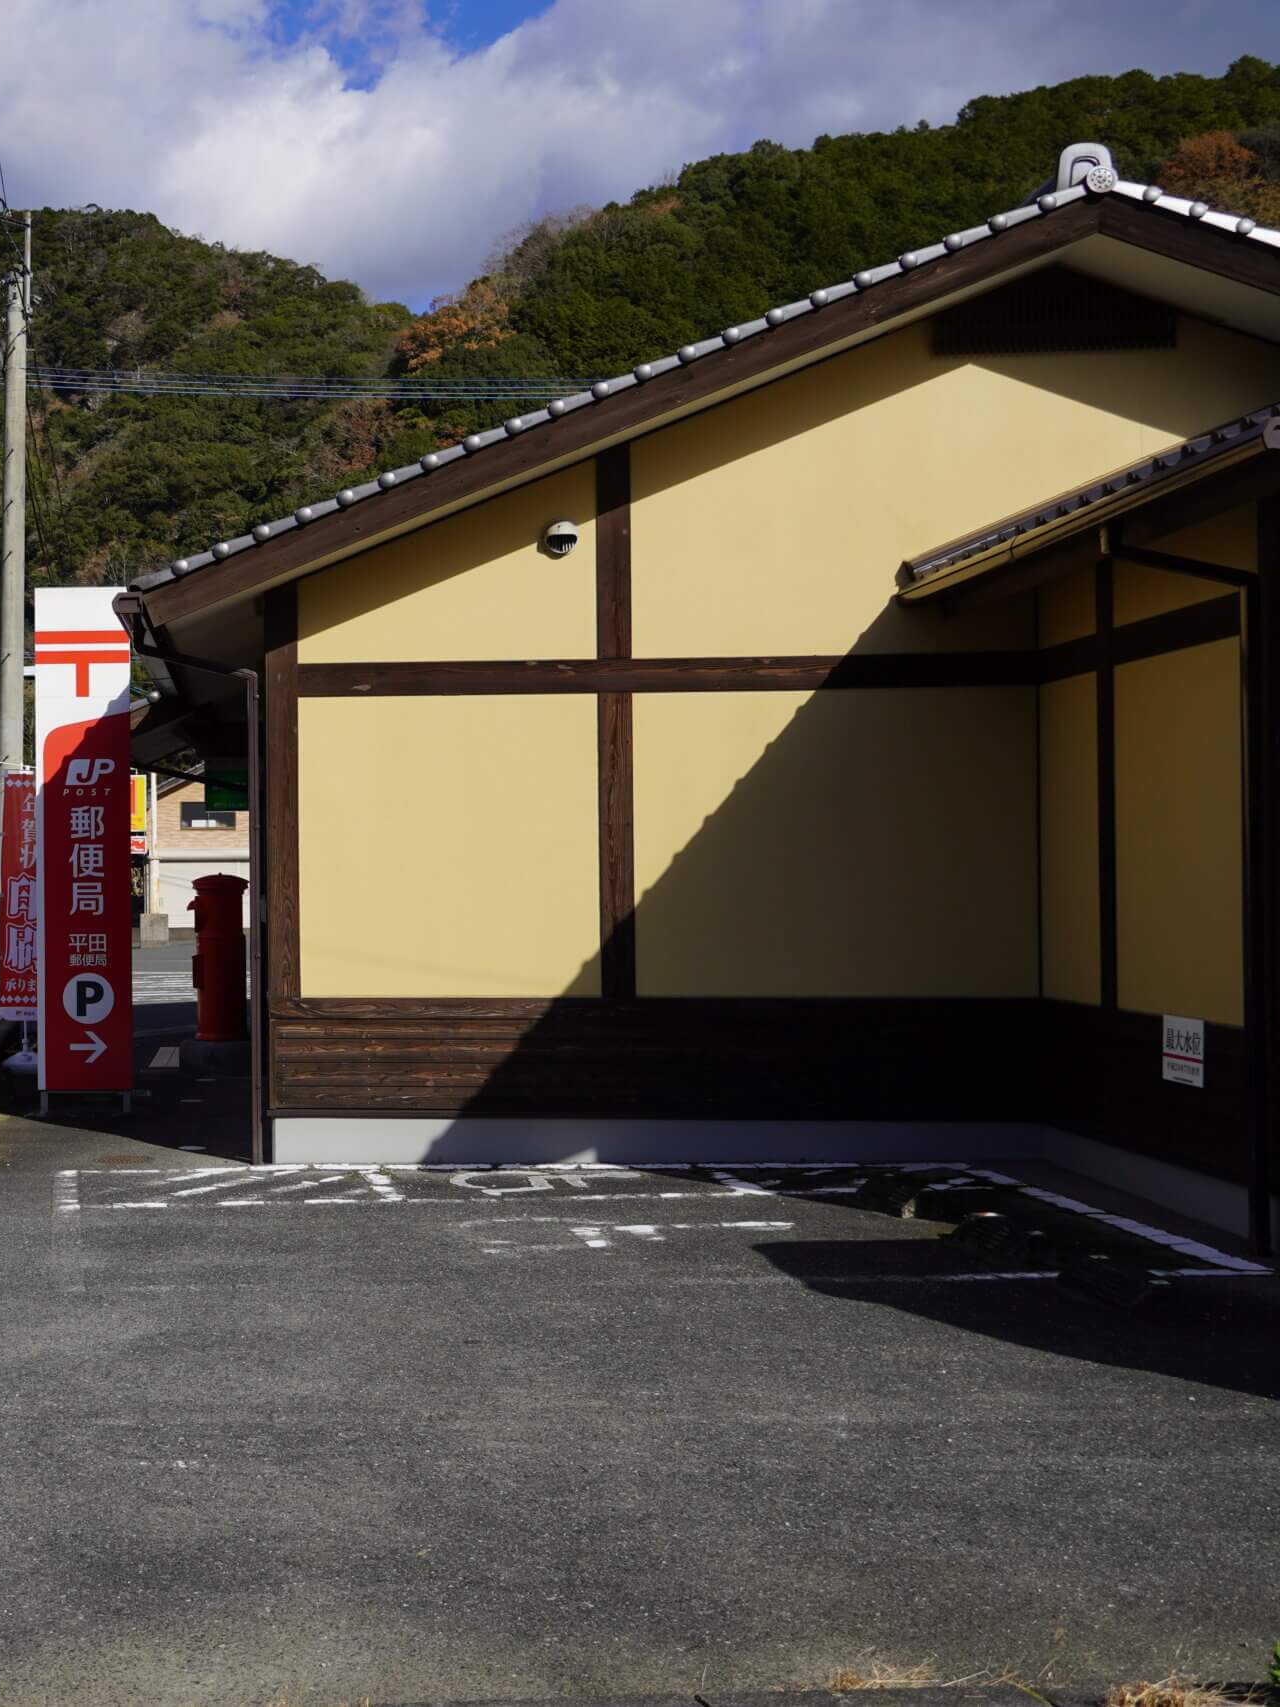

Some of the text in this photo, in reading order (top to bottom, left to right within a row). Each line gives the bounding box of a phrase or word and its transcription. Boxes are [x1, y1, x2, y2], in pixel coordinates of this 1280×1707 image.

[65, 758, 115, 786] JP
[63, 788, 111, 796] POST
[69, 805, 105, 916] 郵便局
[68, 933, 107, 953] 平田
[68, 953, 107, 967] 郵便局
[76, 980, 105, 1017] P
[1166, 1027, 1201, 1056] 最大水位
